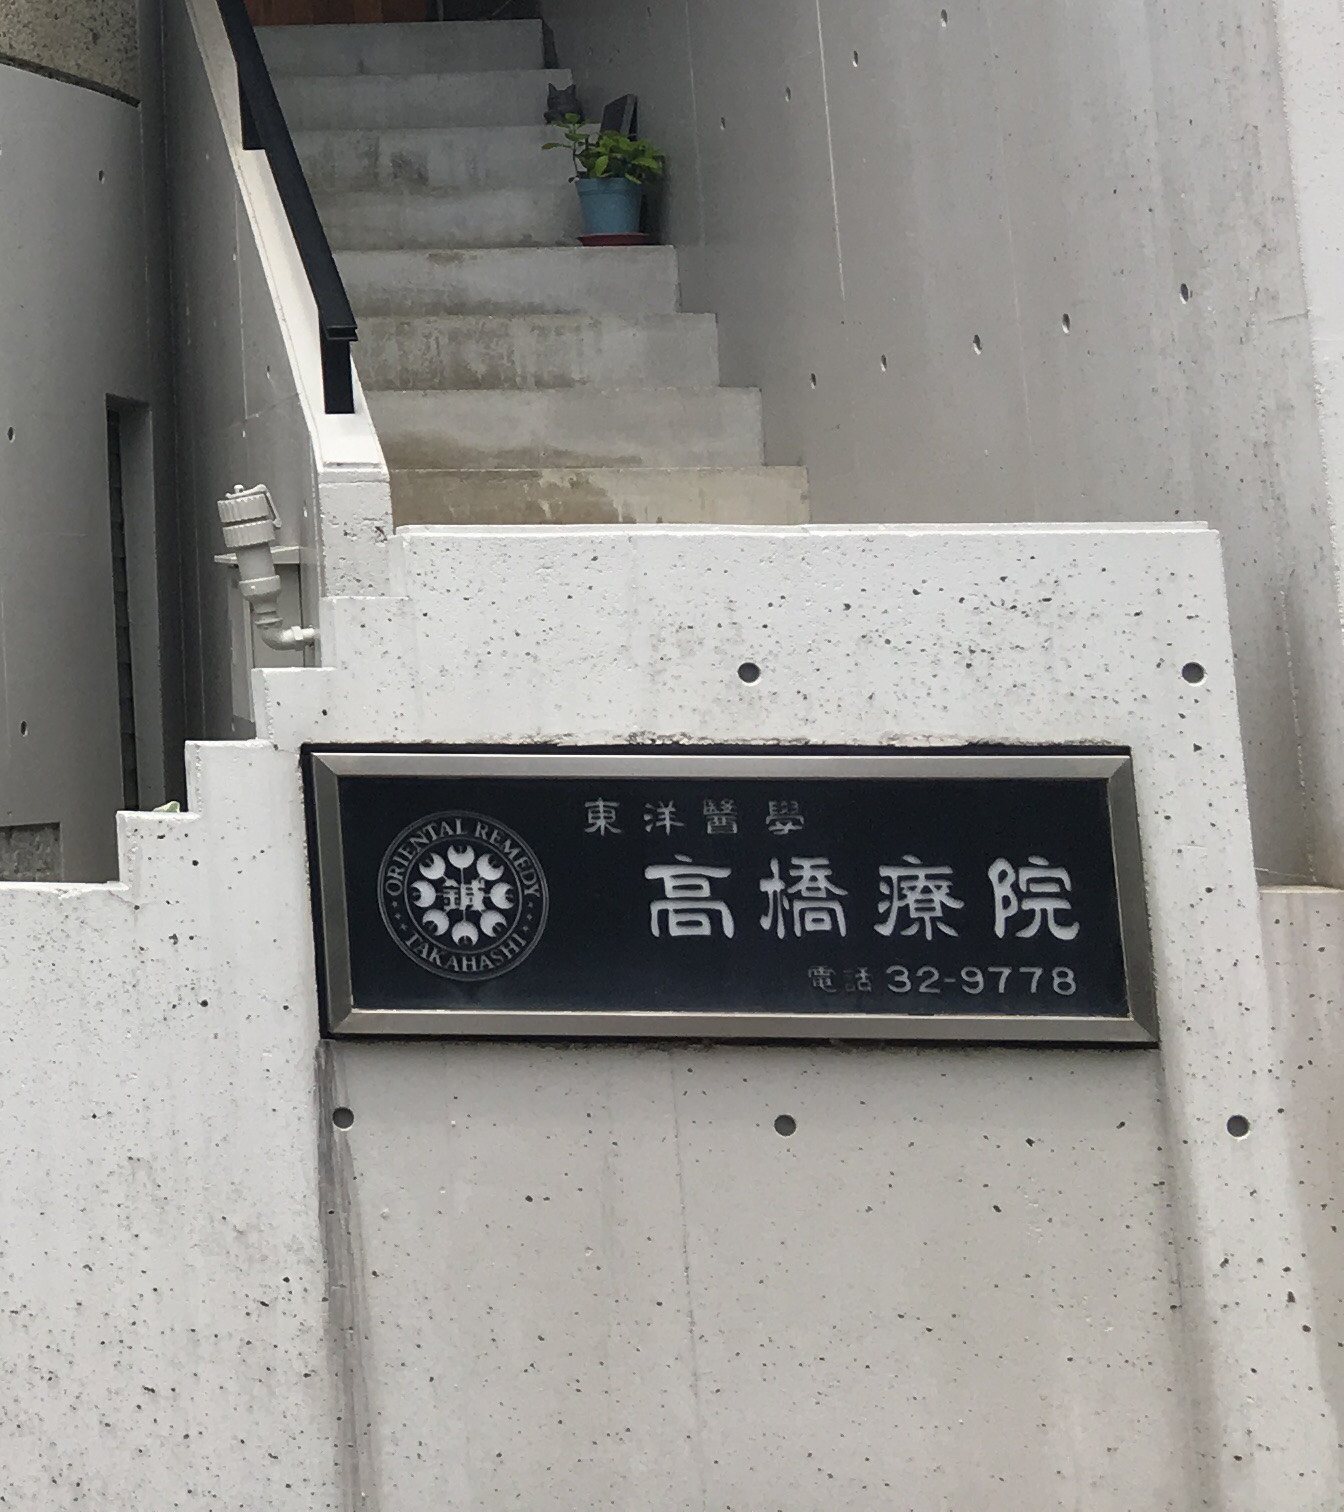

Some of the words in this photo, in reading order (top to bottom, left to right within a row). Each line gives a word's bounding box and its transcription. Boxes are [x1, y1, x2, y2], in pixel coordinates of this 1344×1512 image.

[584, 798, 805, 836] 東洋醫學
[385, 818, 466, 896] ORIENTAL
[474, 821, 540, 897] REMEDY
[644, 854, 1080, 941] 高橋療院
[407, 931, 528, 972] TAKAHASHI
[885, 965, 1076, 995] 32-9778
